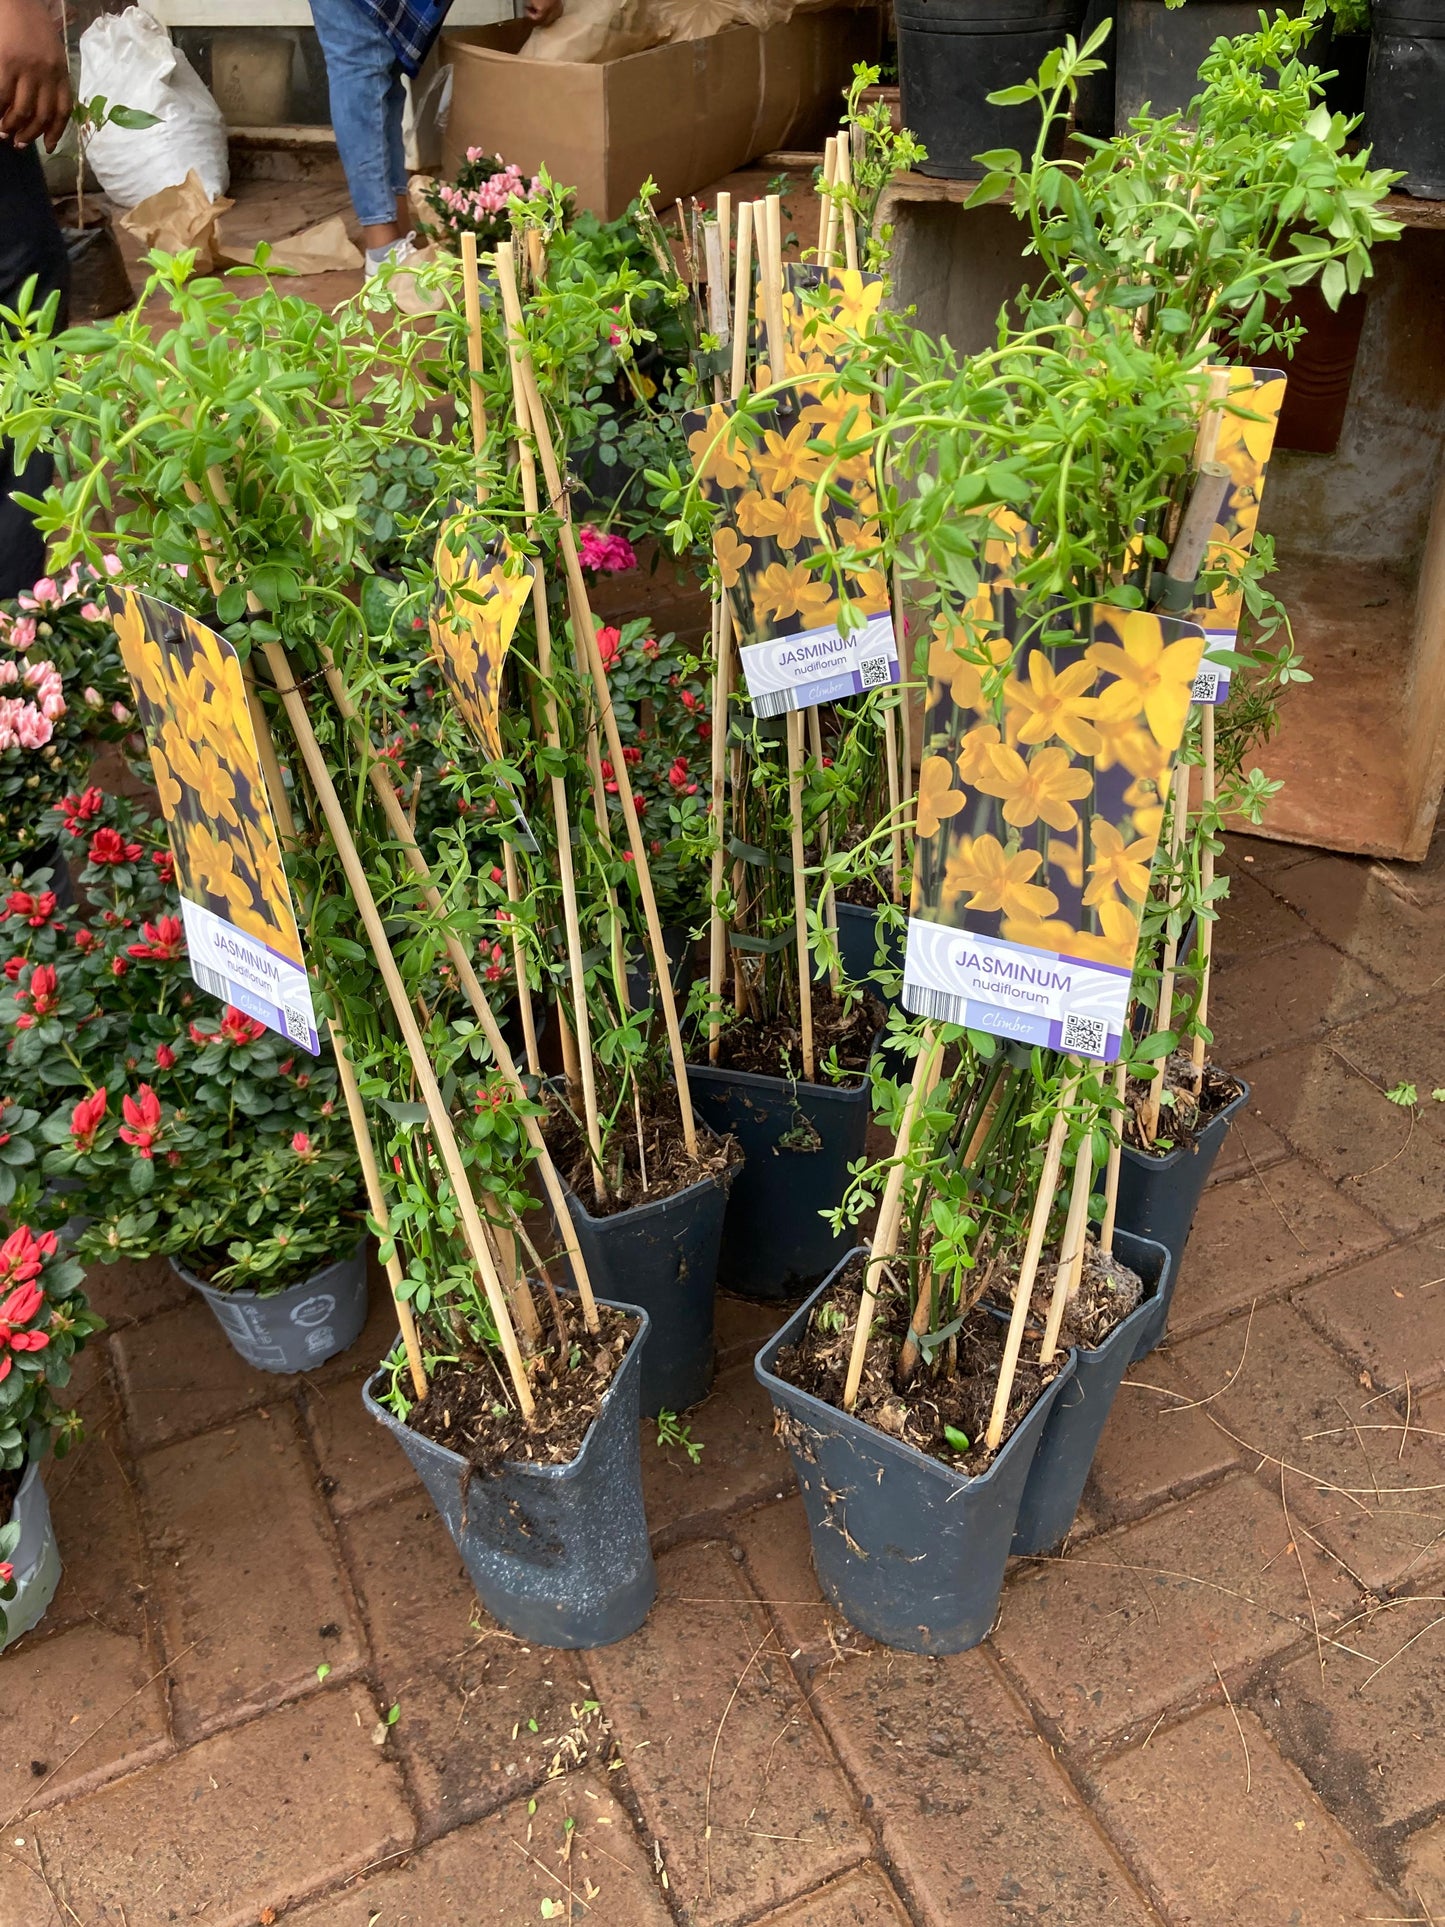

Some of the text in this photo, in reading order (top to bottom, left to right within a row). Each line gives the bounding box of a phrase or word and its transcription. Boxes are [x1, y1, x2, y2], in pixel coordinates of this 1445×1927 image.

[779, 635, 857, 666] JASMINUM
[795, 655, 847, 676] nudiflorum
[808, 681, 845, 700] Climber
[213, 932, 281, 983] JASMINUM
[955, 951, 1072, 993] JASMINUM
[227, 959, 274, 993] nudiflorum
[972, 977, 1050, 1005] nudiflorum
[981, 1012, 1035, 1035] Climber
